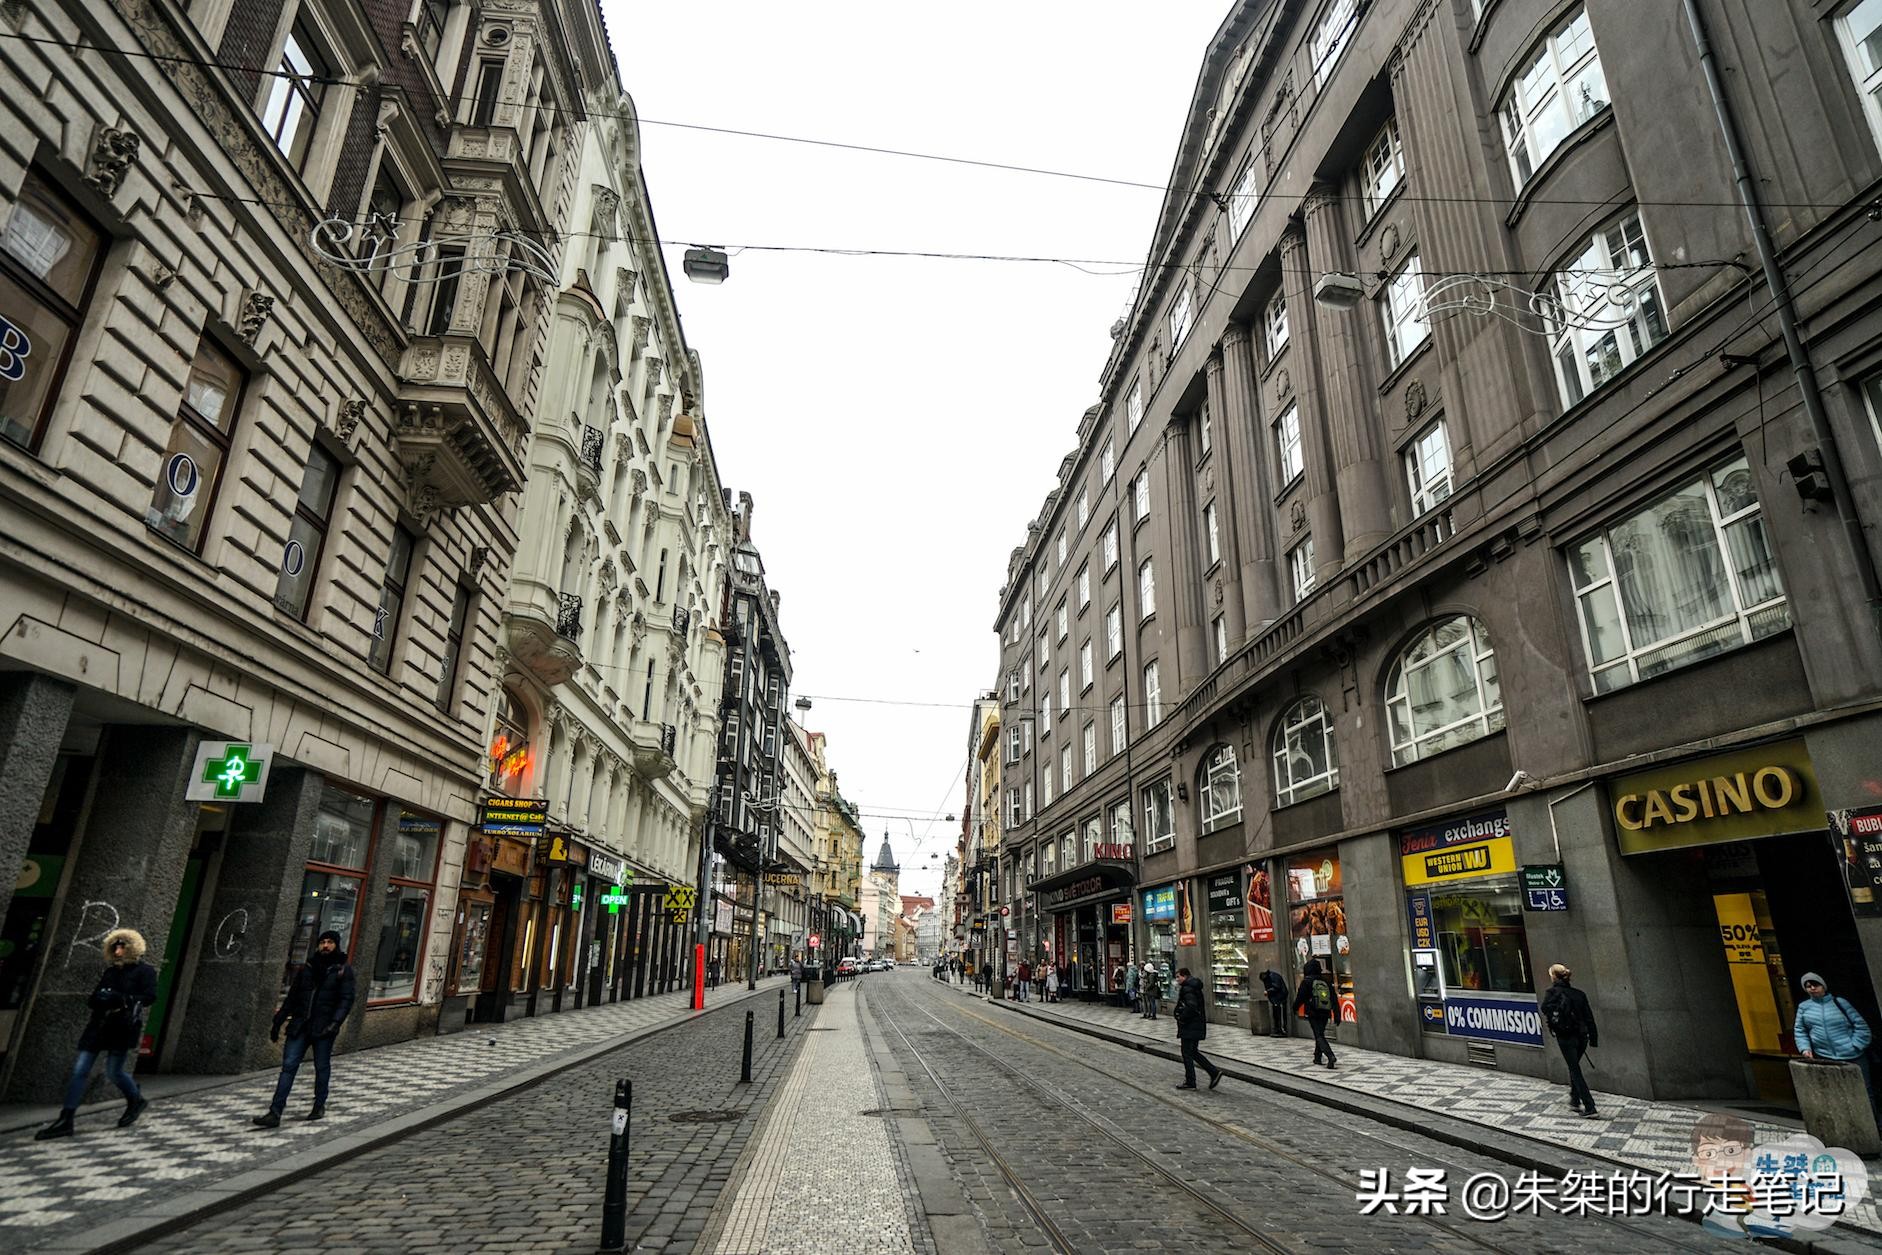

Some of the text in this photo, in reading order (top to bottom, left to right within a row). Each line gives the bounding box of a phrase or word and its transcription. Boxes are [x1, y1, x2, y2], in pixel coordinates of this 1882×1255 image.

[488, 798, 534, 809] CIGARS SHOP
[1615, 766, 1793, 831] CASINO
[1093, 842, 1133, 862] KINO
[1427, 853, 1461, 867] WESTERN
[1463, 848, 1488, 870] WU
[1438, 862, 1463, 874] UNION
[763, 872, 800, 885] UCERNA
[602, 895, 628, 905] OPEN
[1415, 917, 1429, 927] EUR
[1416, 927, 1430, 938] USD
[1721, 925, 1761, 941] 50%
[1417, 938, 1432, 948] CZK
[1447, 1006, 1466, 1028] 0%
